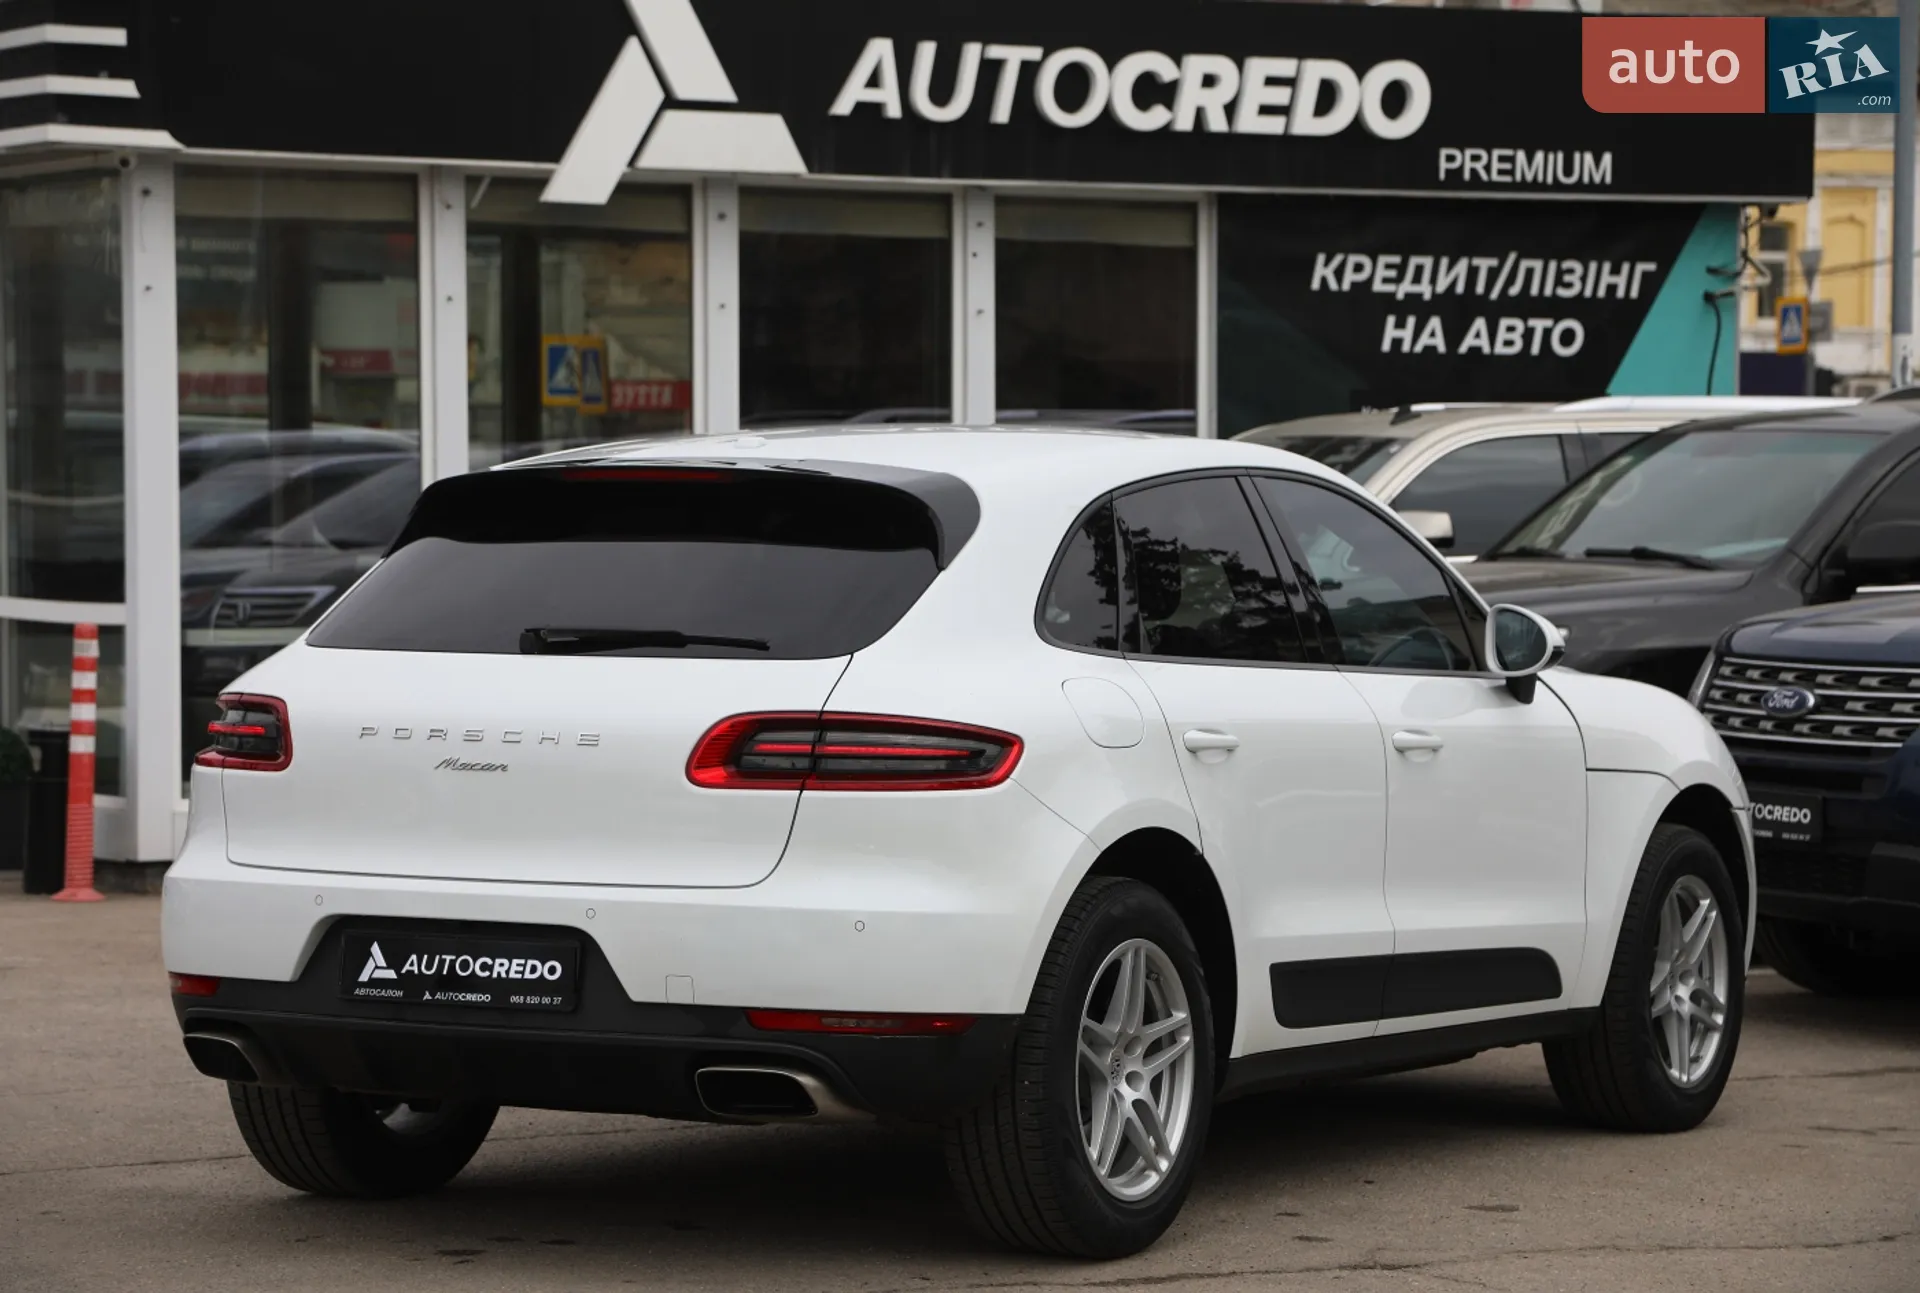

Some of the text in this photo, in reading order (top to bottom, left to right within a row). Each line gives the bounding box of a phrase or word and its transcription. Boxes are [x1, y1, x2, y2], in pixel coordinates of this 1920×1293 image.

[828, 36, 1432, 141] AUTOCREDO
[1437, 147, 1613, 185] PREMIUM
[1310, 251, 1657, 301] КРЕДИТ/ЛІЗІНГ
[1380, 314, 1586, 357] НА АВТО
[1767, 690, 1800, 709] Ford
[359, 724, 600, 746] PORSCHE
[433, 756, 509, 772] Macan
[1751, 802, 1811, 824] TOCREDO
[401, 954, 563, 980] AUTOCREDO
[354, 987, 403, 997] АВТОСАЛОН
[434, 992, 491, 1002] AUTOCREDO
